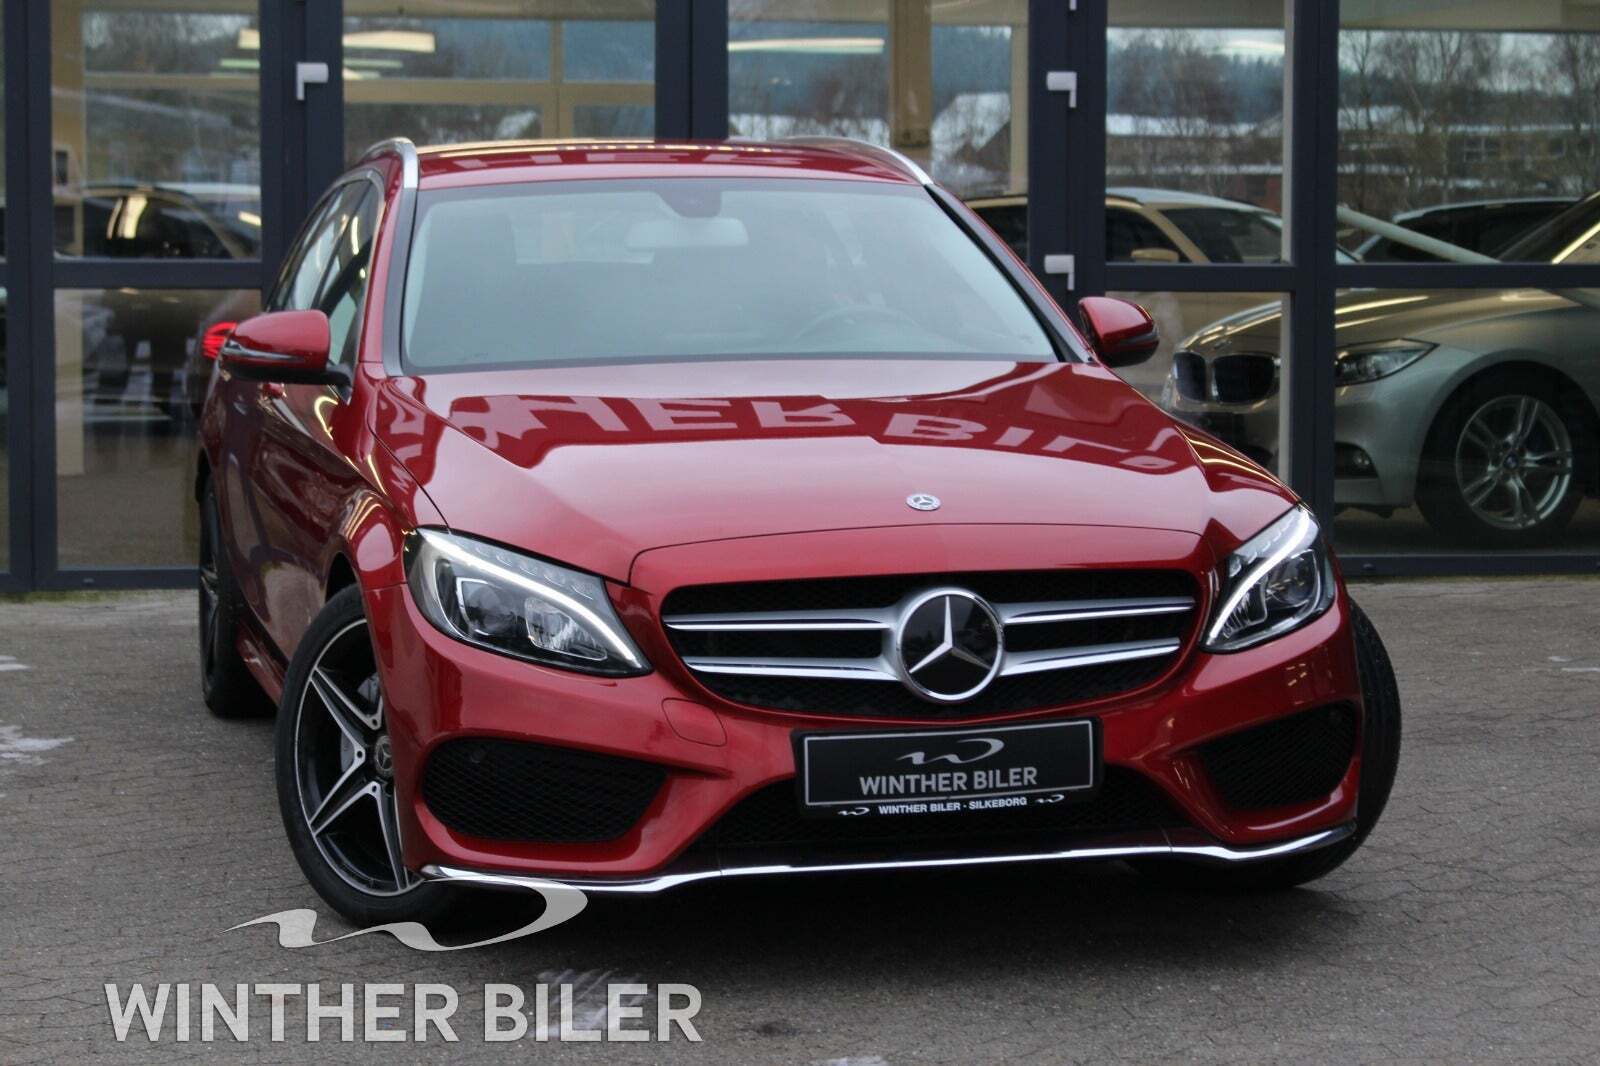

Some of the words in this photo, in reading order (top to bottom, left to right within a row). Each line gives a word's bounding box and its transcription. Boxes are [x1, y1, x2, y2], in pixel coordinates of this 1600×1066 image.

[859, 773, 968, 796] WINTHER
[973, 766, 1038, 790] BILER
[878, 804, 928, 815] WINTHER
[930, 802, 961, 812] BILER
[969, 797, 1028, 810] SILKEBORG
